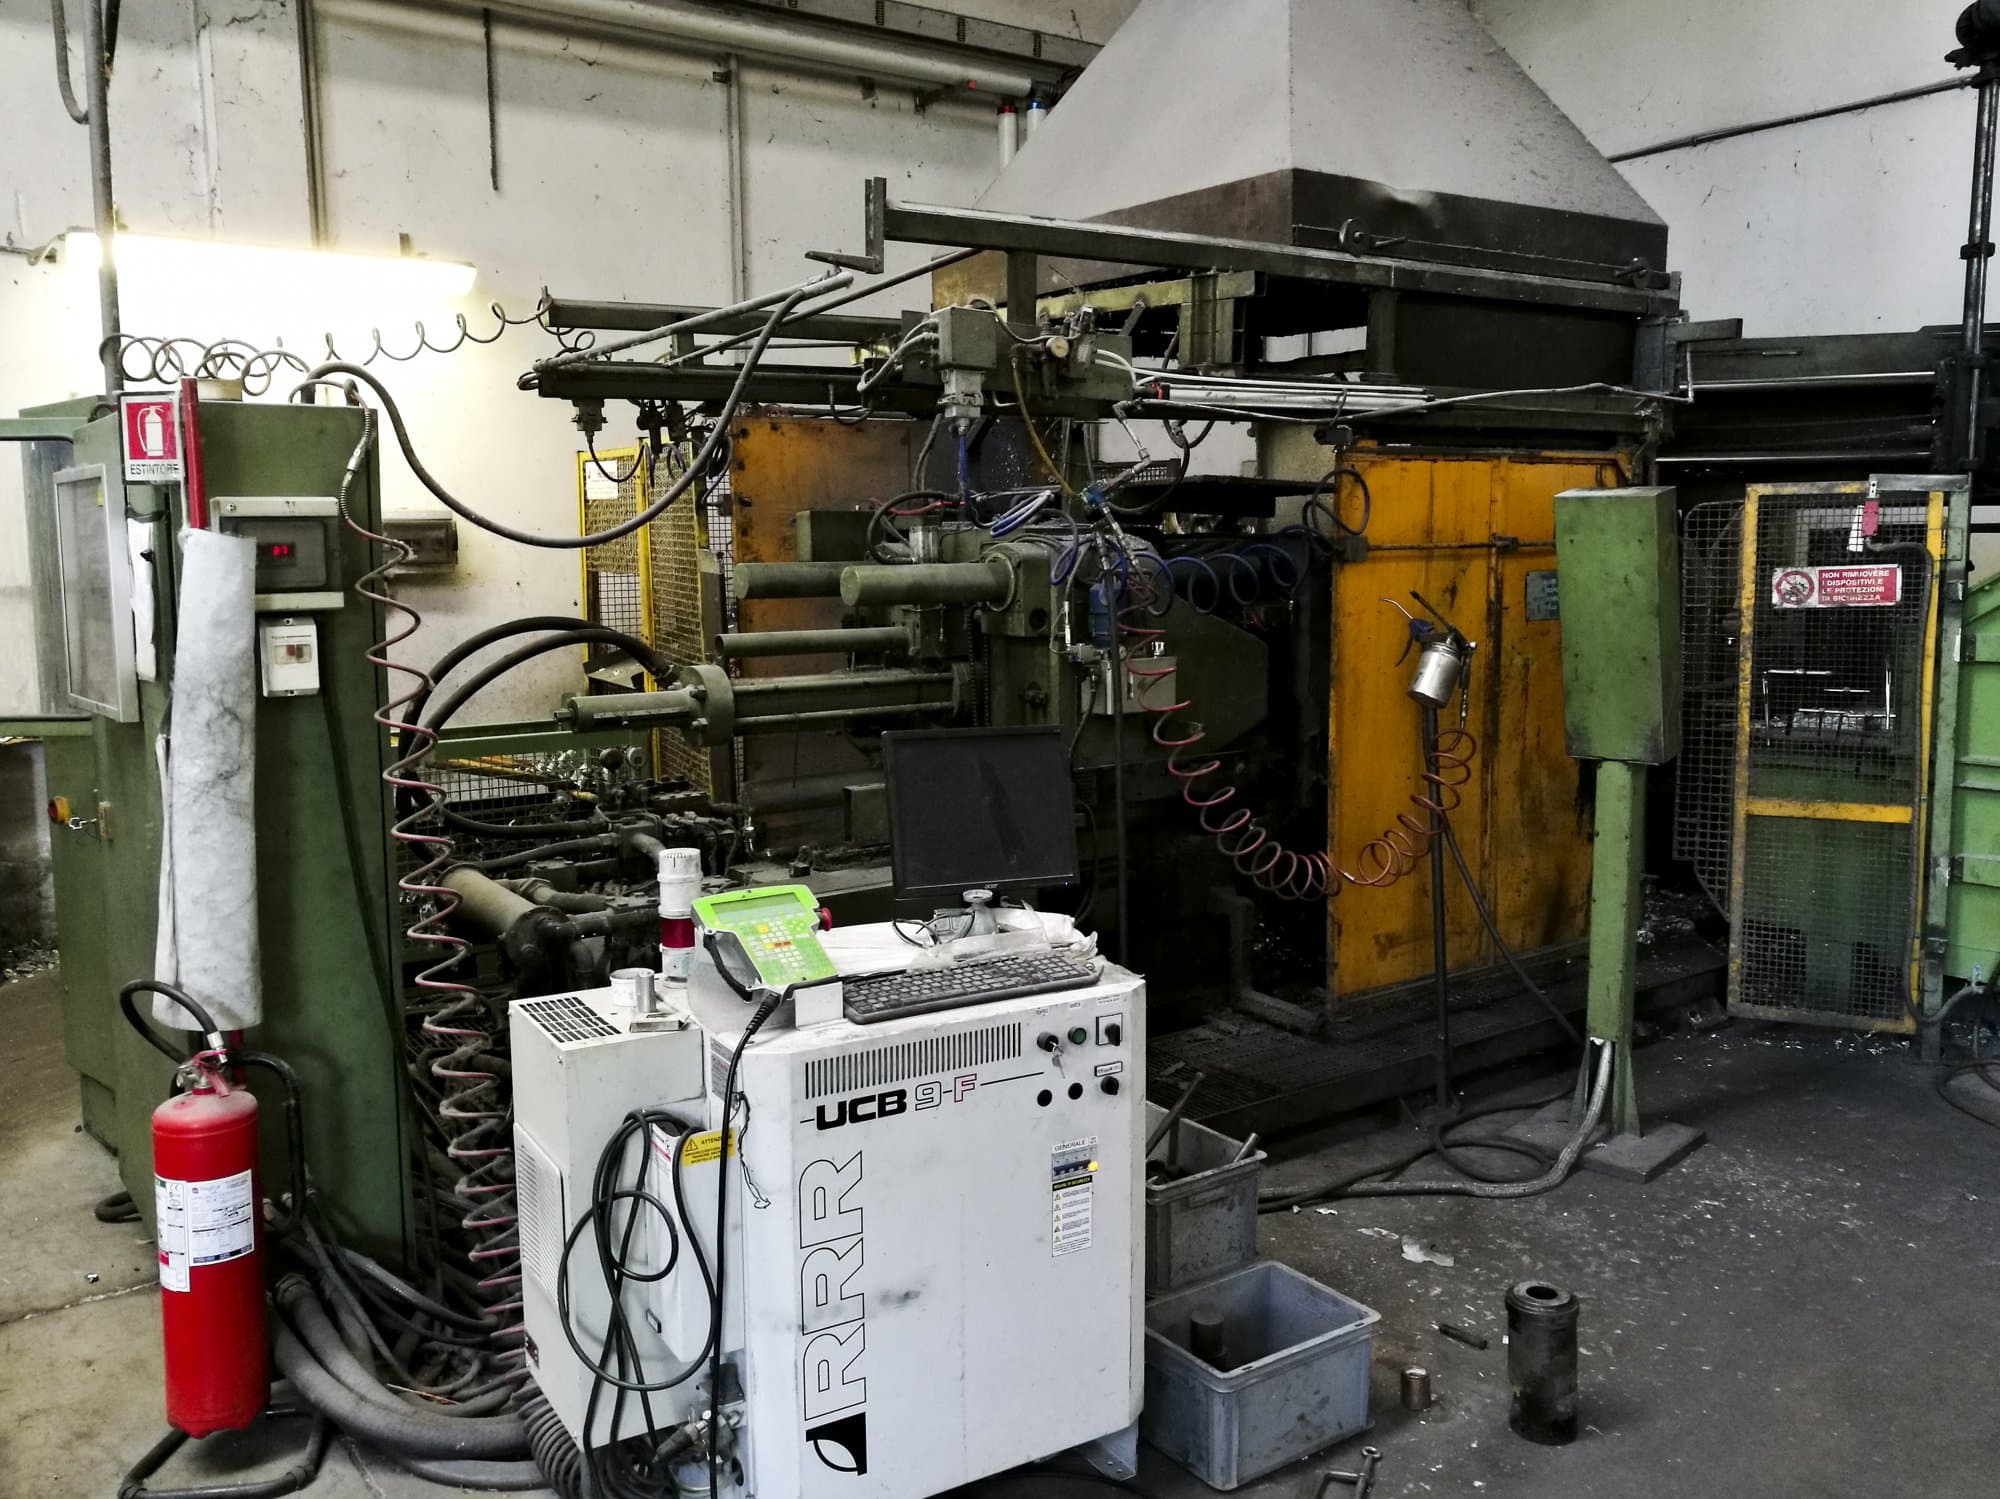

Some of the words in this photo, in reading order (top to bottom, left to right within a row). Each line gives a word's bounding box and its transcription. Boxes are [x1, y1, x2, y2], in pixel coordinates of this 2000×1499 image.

[130, 463, 180, 475] ESTINTORE
[1842, 570, 1889, 578] RIMUOVERE
[816, 1088, 907, 1131] UCB
[1054, 1139, 1086, 1151] GENERALE
